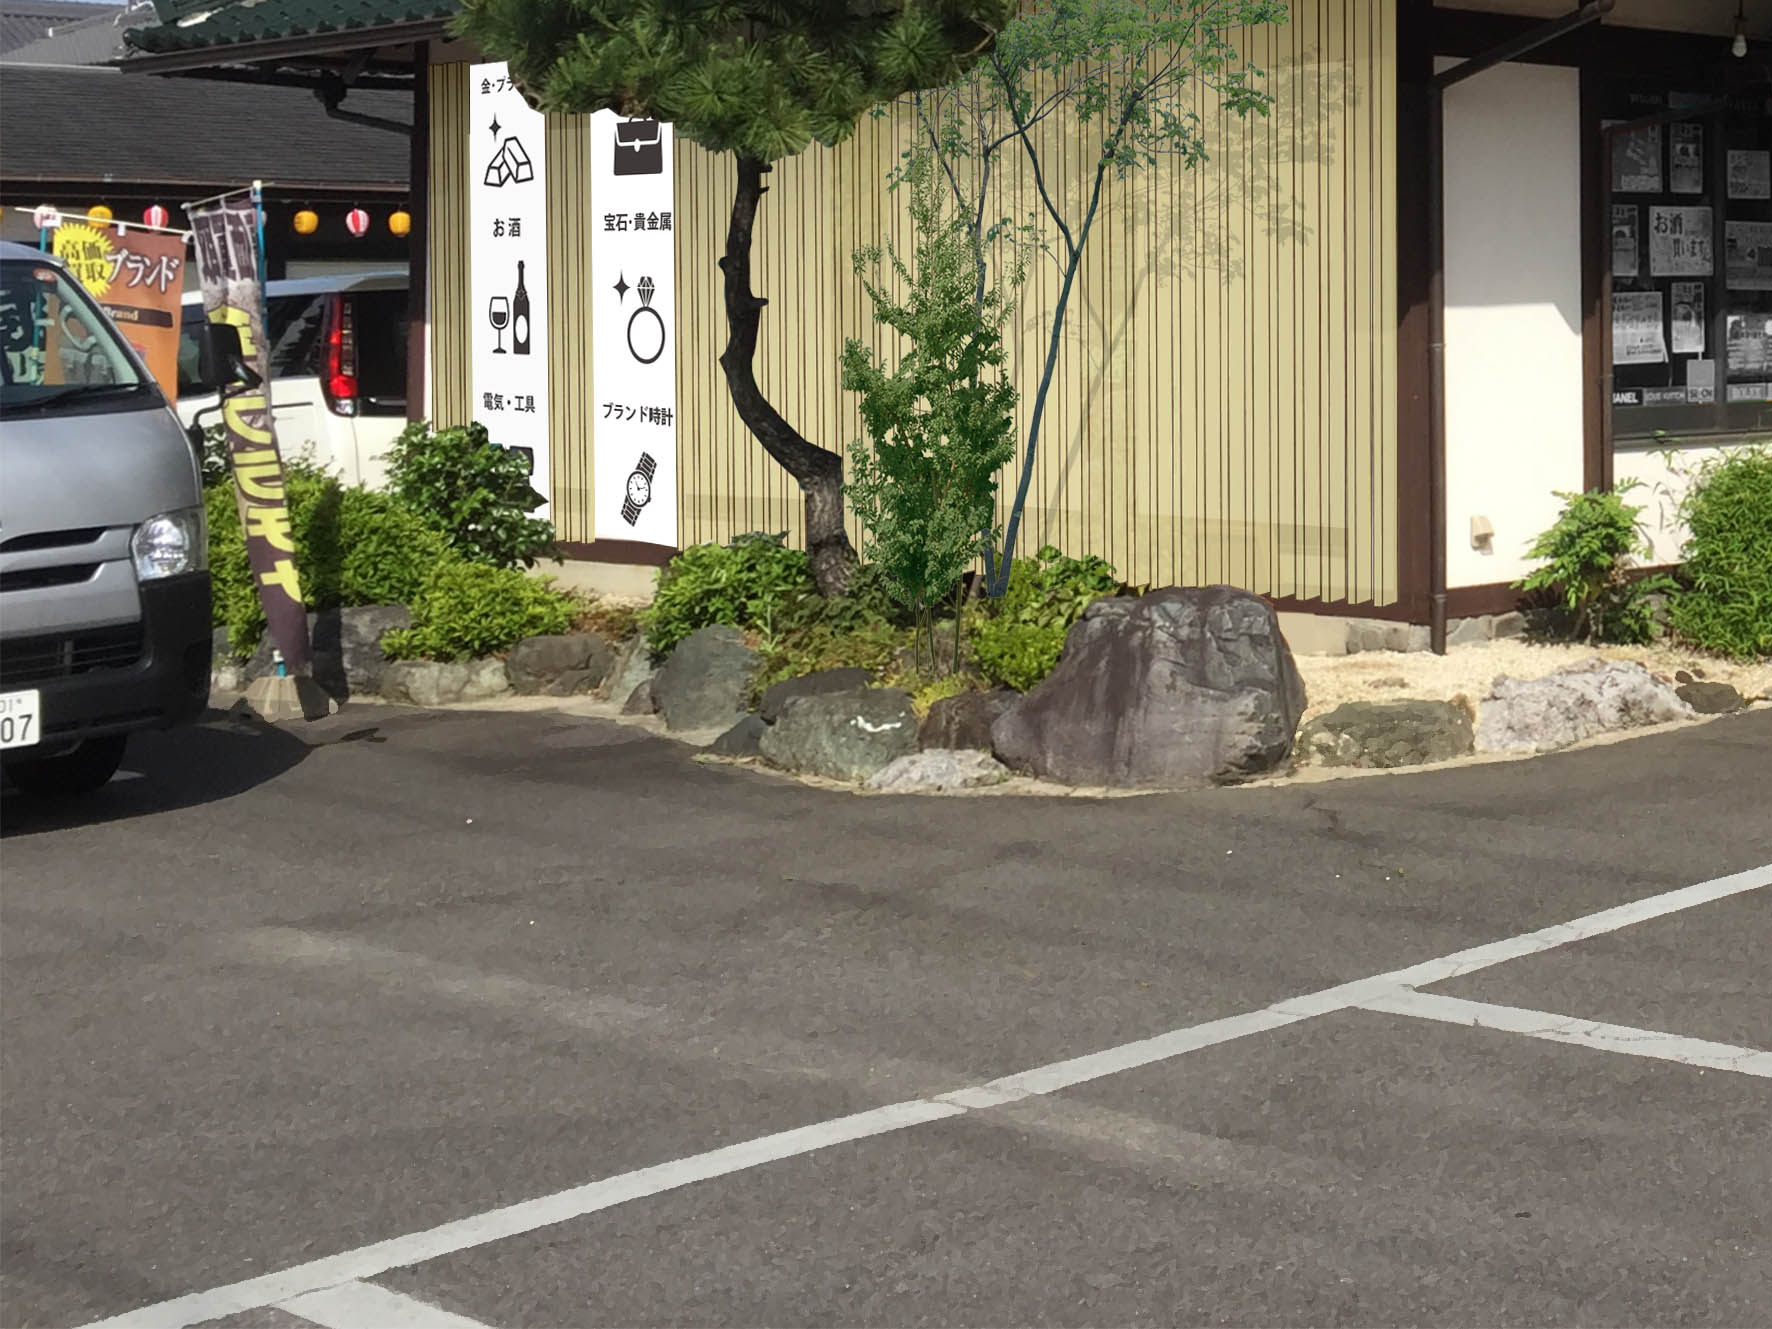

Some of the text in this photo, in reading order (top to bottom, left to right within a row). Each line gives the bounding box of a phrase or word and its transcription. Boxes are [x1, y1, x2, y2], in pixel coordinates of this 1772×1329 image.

[493, 217, 521, 237] お酒
[604, 211, 672, 232] 宝石・貴金属
[105, 247, 181, 293] ブランド
[483, 392, 535, 413] 電気・工具
[602, 403, 674, 427] ブランド時計
